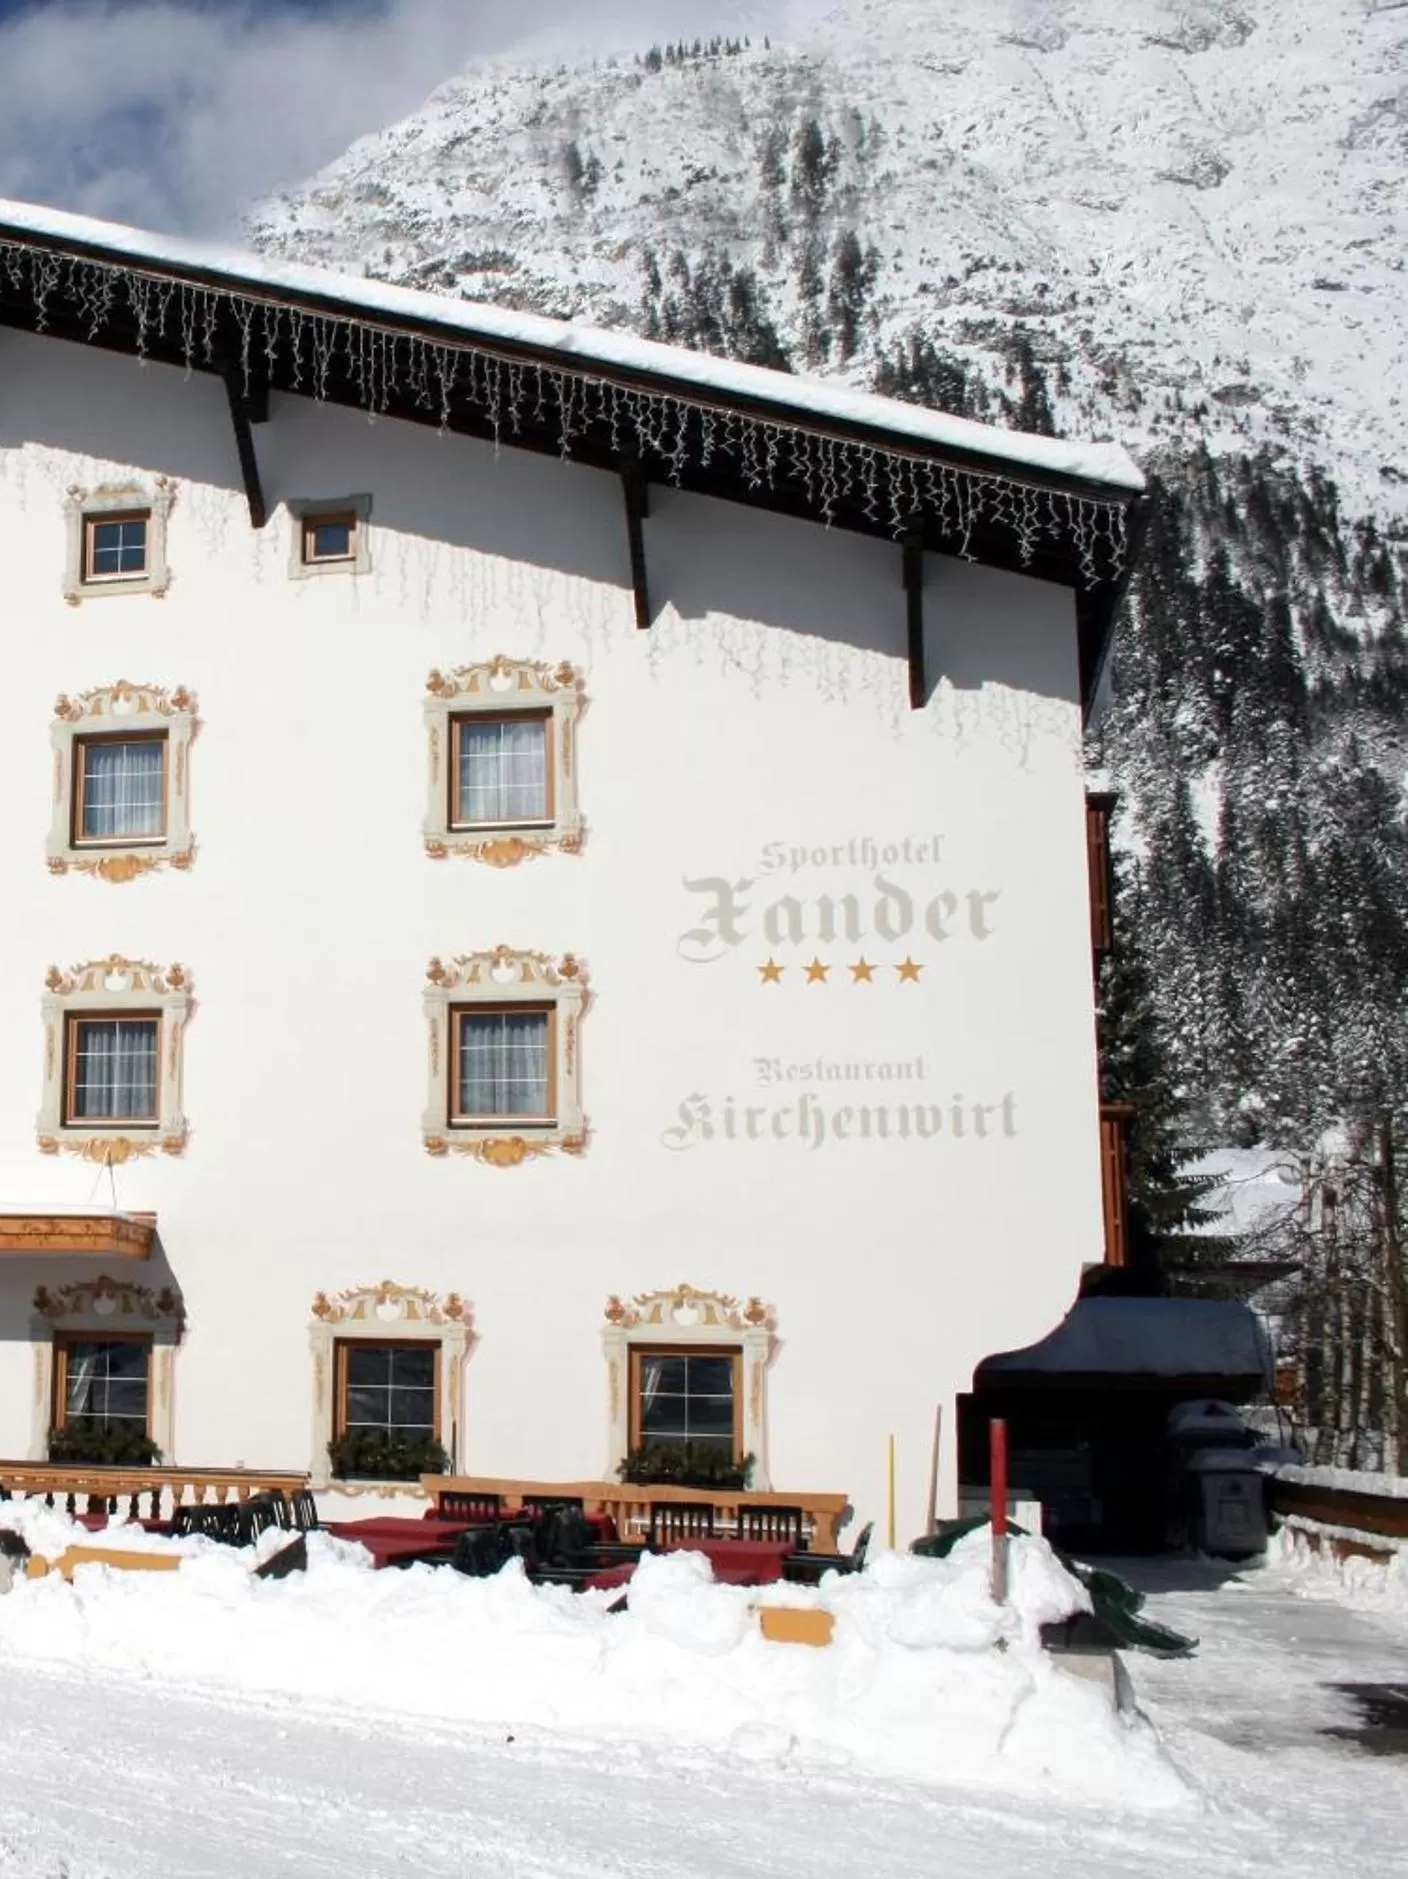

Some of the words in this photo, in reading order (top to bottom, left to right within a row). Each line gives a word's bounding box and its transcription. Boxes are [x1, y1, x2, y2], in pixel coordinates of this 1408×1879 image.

[759, 833, 945, 874] Sporthotel
[677, 872, 1002, 963] Xander
[752, 1056, 926, 1088] Restaurant
[660, 1090, 1019, 1151] Kirchenwirt
